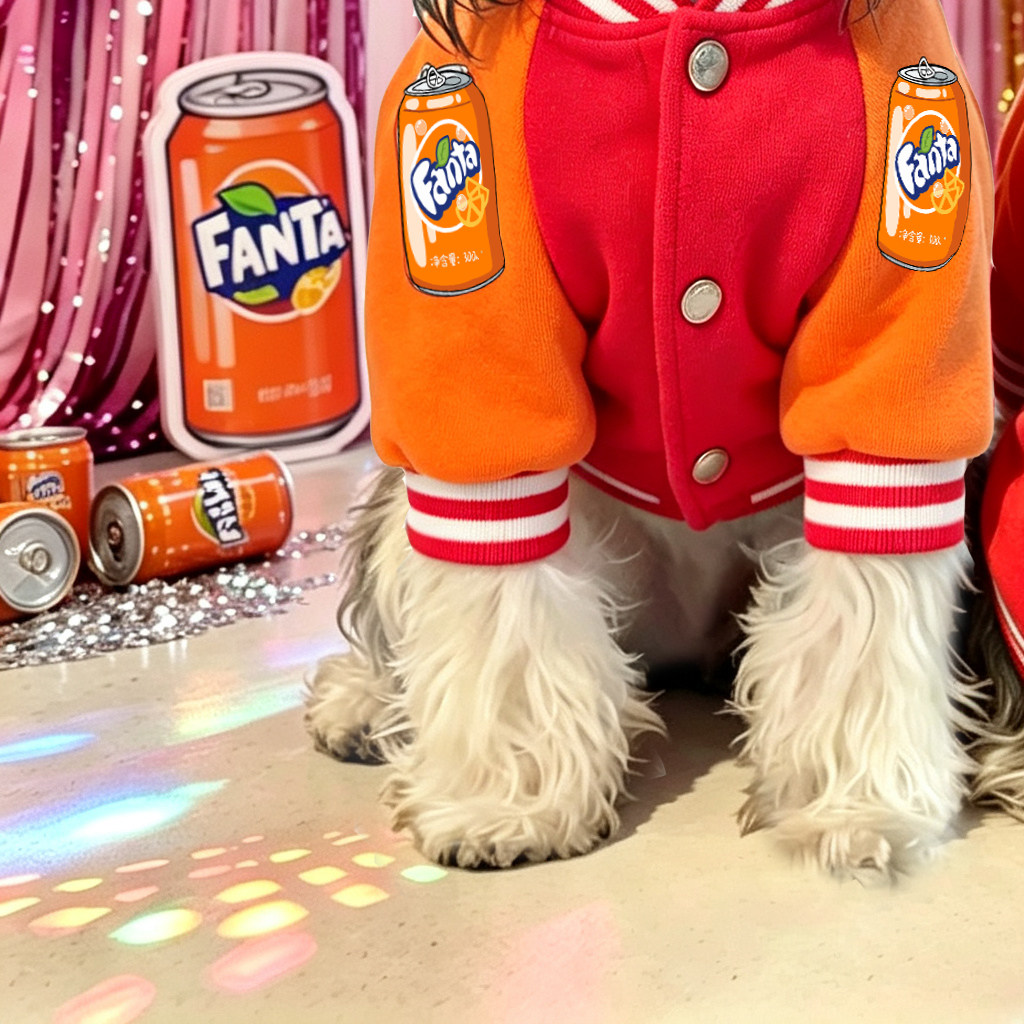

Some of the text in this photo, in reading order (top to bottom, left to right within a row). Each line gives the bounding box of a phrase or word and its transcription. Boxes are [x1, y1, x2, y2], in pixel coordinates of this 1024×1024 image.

[412, 141, 478, 216] Fanta
[898, 132, 958, 195] Fanta
[194, 197, 347, 289] FANTA
